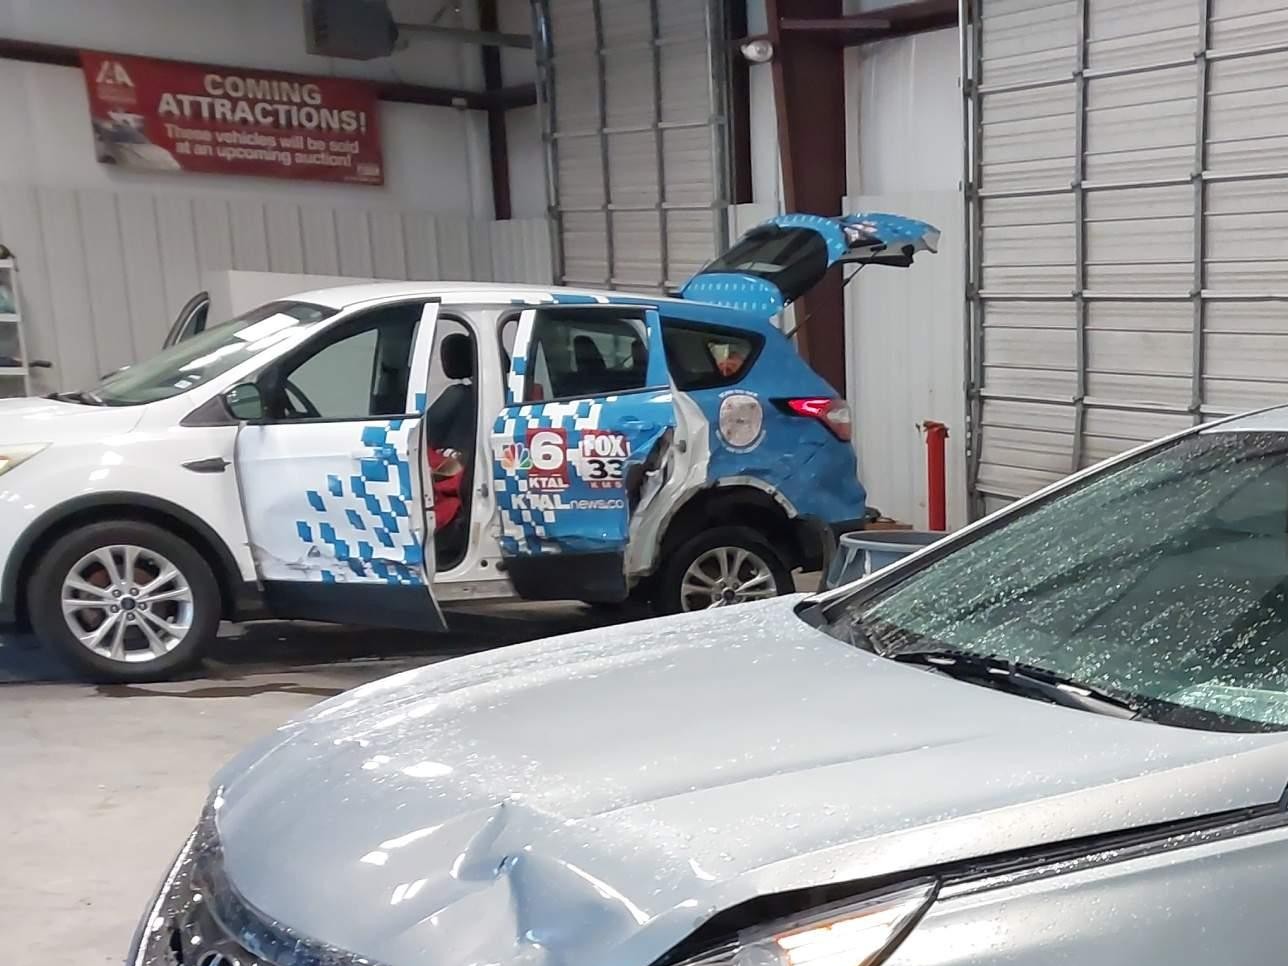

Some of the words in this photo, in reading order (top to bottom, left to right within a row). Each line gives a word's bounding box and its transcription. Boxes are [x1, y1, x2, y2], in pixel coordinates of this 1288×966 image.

[203, 74, 322, 106] COMING
[158, 92, 368, 135] ATTRACTIONS!
[164, 123, 212, 141] These
[216, 129, 276, 147] vehicles
[280, 133, 304, 149] will
[307, 136, 326, 150] be
[329, 139, 360, 154] sold
[176, 141, 190, 154] at
[194, 144, 213, 156] an
[217, 146, 292, 166] upcoming
[295, 152, 352, 167] auction!
[530, 431, 564, 470] 6
[583, 434, 626, 457] FOX
[528, 477, 570, 489] KTAL
[587, 459, 623, 479] 33
